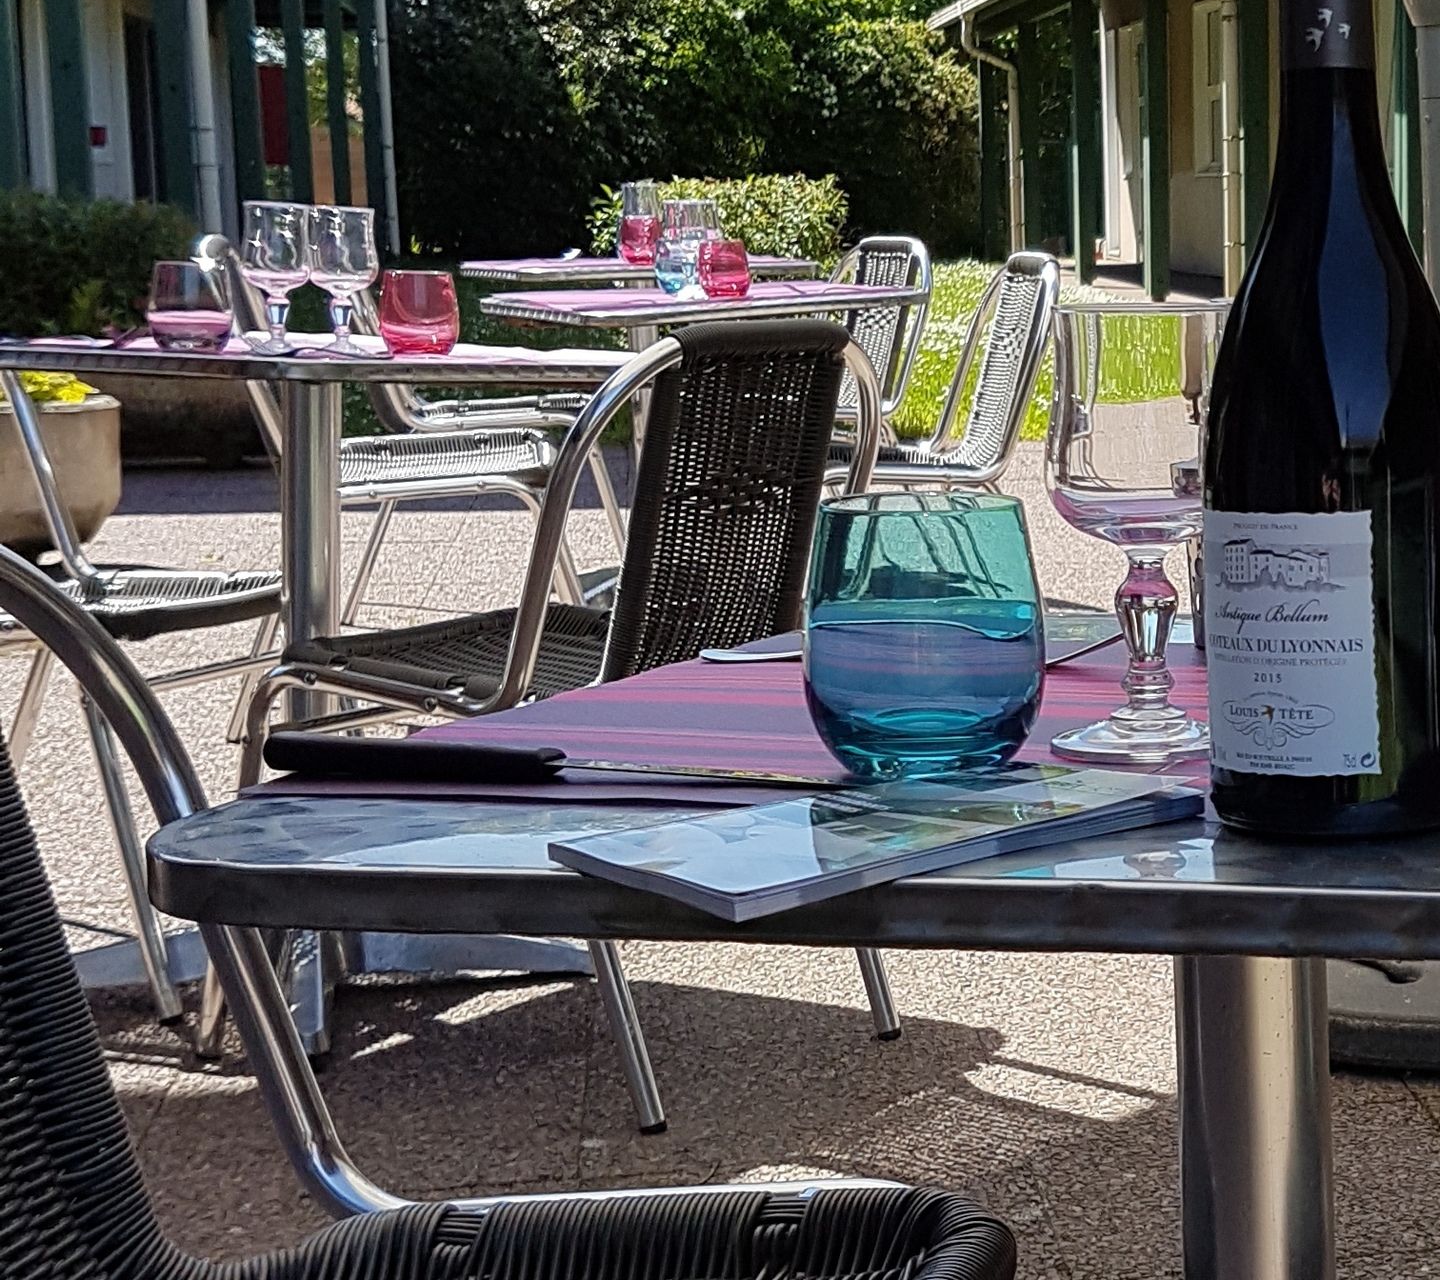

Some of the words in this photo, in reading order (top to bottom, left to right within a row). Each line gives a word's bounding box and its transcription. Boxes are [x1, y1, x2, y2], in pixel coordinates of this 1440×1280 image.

[1215, 601, 1261, 635] Antique
[1265, 599, 1330, 623] Bellum
[1256, 638, 1278, 653] DU
[1282, 639, 1364, 654] LYONNAIS
[1253, 672, 1283, 684] 2015
[1229, 705, 1259, 718] LOUIS
[1279, 707, 1315, 721] TÊTE
